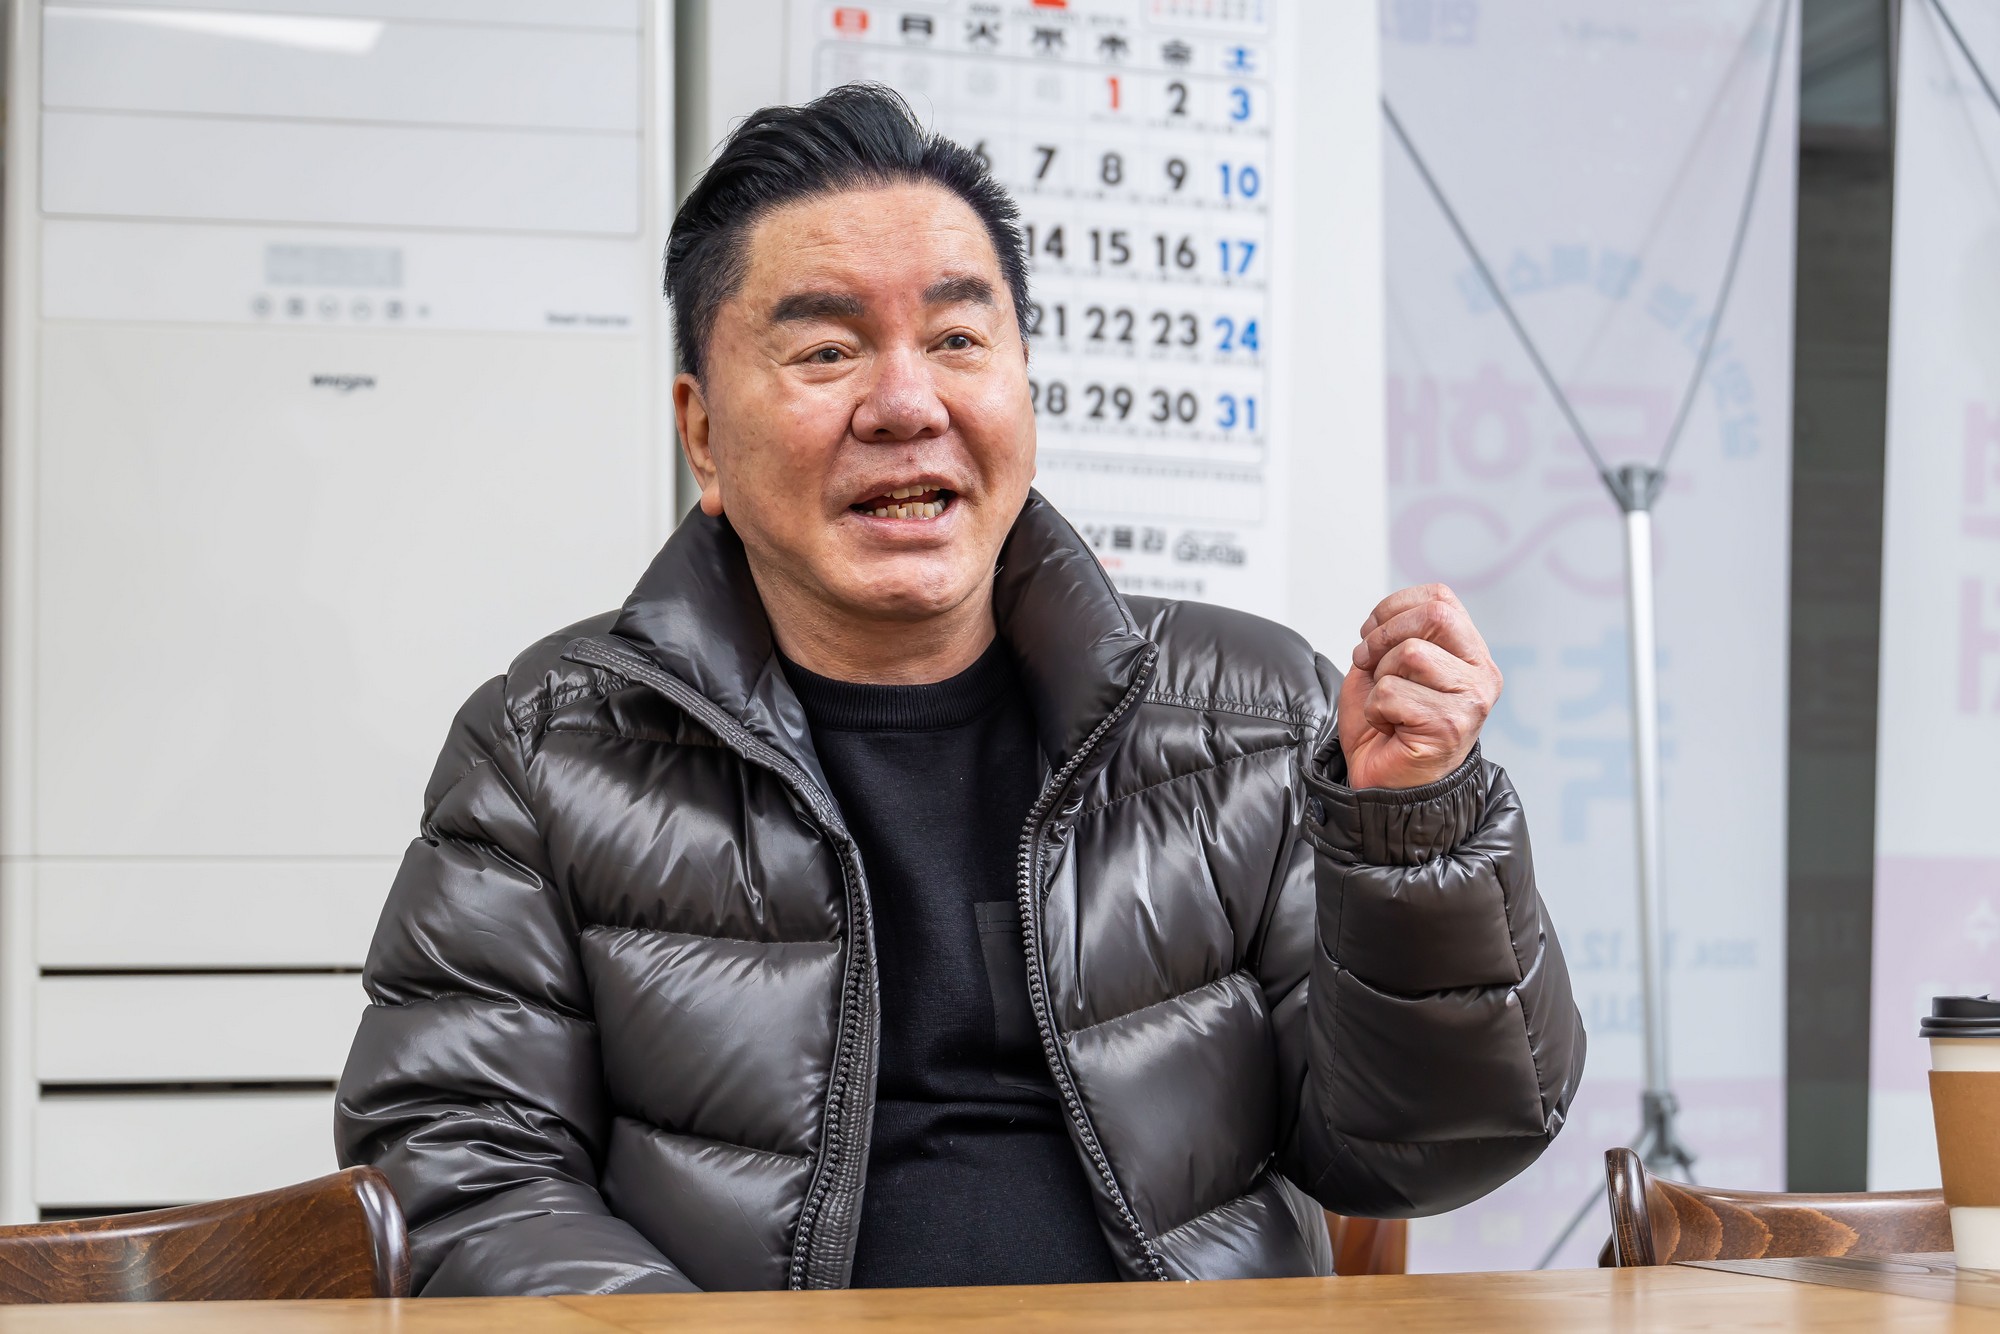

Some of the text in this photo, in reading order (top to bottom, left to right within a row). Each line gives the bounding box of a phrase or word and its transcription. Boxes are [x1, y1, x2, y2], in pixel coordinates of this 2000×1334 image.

[1107, 76, 1252, 123] 1 2 3
[1035, 145, 1058, 181] 7
[1099, 151, 1124, 188] 8
[1164, 157, 1188, 192] 9
[1218, 162, 1261, 200] 10
[1025, 224, 1066, 261] 14
[1089, 228, 1132, 266] 15
[1154, 233, 1197, 271] 16
[1218, 239, 1258, 276] 17
[1029, 301, 1260, 353] 21 22 23 24
[1084, 383, 1135, 422] 29
[1150, 388, 1199, 426] 30
[1217, 393, 1257, 432] 31
